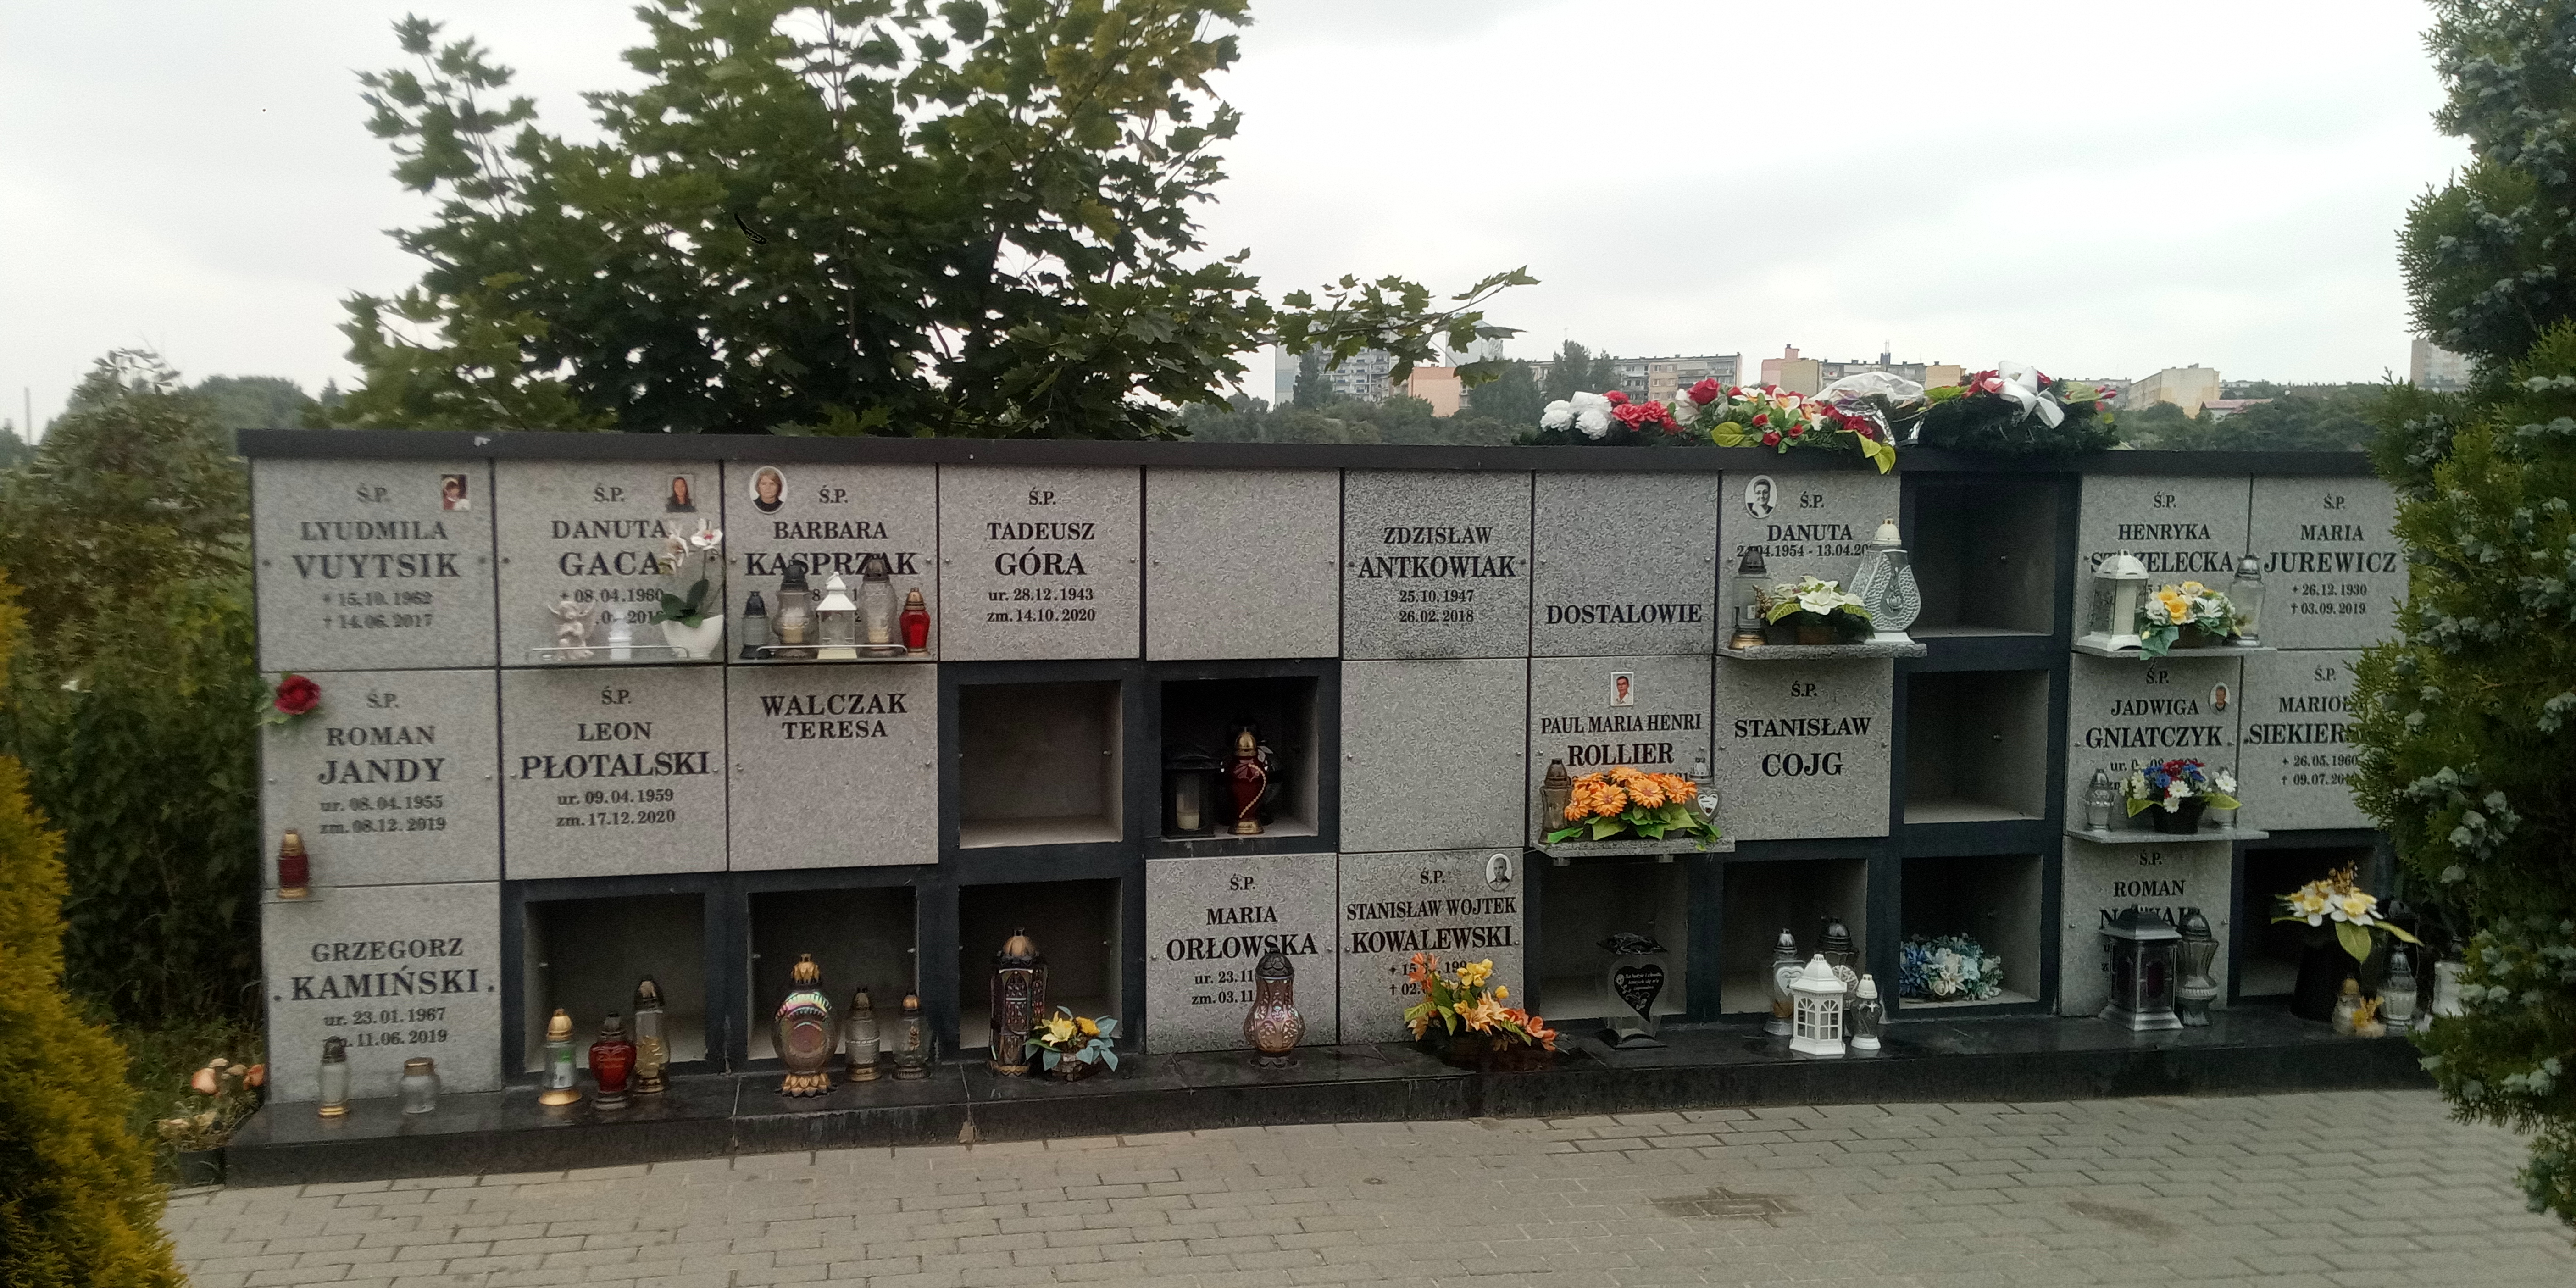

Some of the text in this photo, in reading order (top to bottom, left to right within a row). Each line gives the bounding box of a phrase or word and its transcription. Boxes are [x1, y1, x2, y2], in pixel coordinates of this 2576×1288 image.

[594, 483, 625, 502] Ś.P.
[819, 485, 848, 503] Ś.P.
[1029, 487, 1056, 505] Ś.P.
[1800, 491, 1824, 508] Ś.P.
[2154, 491, 2176, 508] Ś.P.
[2324, 493, 2345, 509] Ś.P.
[300, 521, 448, 540] LYUDMILA
[551, 520, 668, 539] DANUTA
[773, 521, 888, 539] BARBARA
[987, 522, 1095, 540] TADEUSZ
[1383, 527, 1493, 544] ZDZISŁAW
[1767, 524, 1853, 541] DANUTA
[2118, 524, 2210, 540] HENRYKA
[2301, 524, 2364, 541] MARIA
[292, 553, 460, 579] VUYTSIK
[559, 552, 661, 576] GACA
[995, 546, 1087, 575] GÓRA
[1358, 556, 1516, 578] ANTKOWIAK
[2264, 552, 2397, 573] JUREWICZ
[988, 588, 1094, 601] ur. 28.12.1943
[987, 609, 1095, 622] zm. 14.10.2020
[1546, 604, 1702, 624] DOSTALOWIE
[2314, 664, 2336, 681] Ś.P.
[601, 686, 631, 705] Ś.P.
[1791, 681, 1817, 697] Ś.P.
[760, 694, 907, 717] WALCZAK
[2111, 700, 2199, 716] JADWIGA
[2279, 696, 2355, 713] MARIOL
[578, 722, 652, 741] LEON
[782, 720, 888, 740] TERESA
[1541, 713, 1701, 734] PAUL MARIA HENRI
[1735, 717, 1871, 738] STANISŁAW
[326, 726, 435, 746] ROMAN
[2086, 726, 2223, 748] GNIATCZYK
[1568, 743, 1674, 766] ROLLIER
[317, 758, 445, 784] JANDY
[520, 751, 709, 780] PŁOTALSKI
[1762, 752, 1843, 777] COJG
[2110, 762, 2127, 772] ur.
[557, 795, 580, 805] ur.
[556, 816, 584, 827] zm.
[2140, 849, 2163, 866] Ś.P.
[1230, 873, 1256, 890] Ś.P.
[2113, 880, 2186, 898] ROMAN
[1206, 906, 1277, 925] MARIA
[1347, 897, 1517, 921] STANISŁAW WOJTEK
[1167, 933, 1318, 961] ORŁOWSKA
[1352, 926, 1512, 954] KOWALEWSKI
[312, 938, 463, 963] GRZEGORZ
[292, 965, 479, 1001] KAMIŃSKI
[1194, 974, 1213, 984] ur.
[1192, 995, 1216, 1005] zm.
[324, 1015, 348, 1026] ur.
